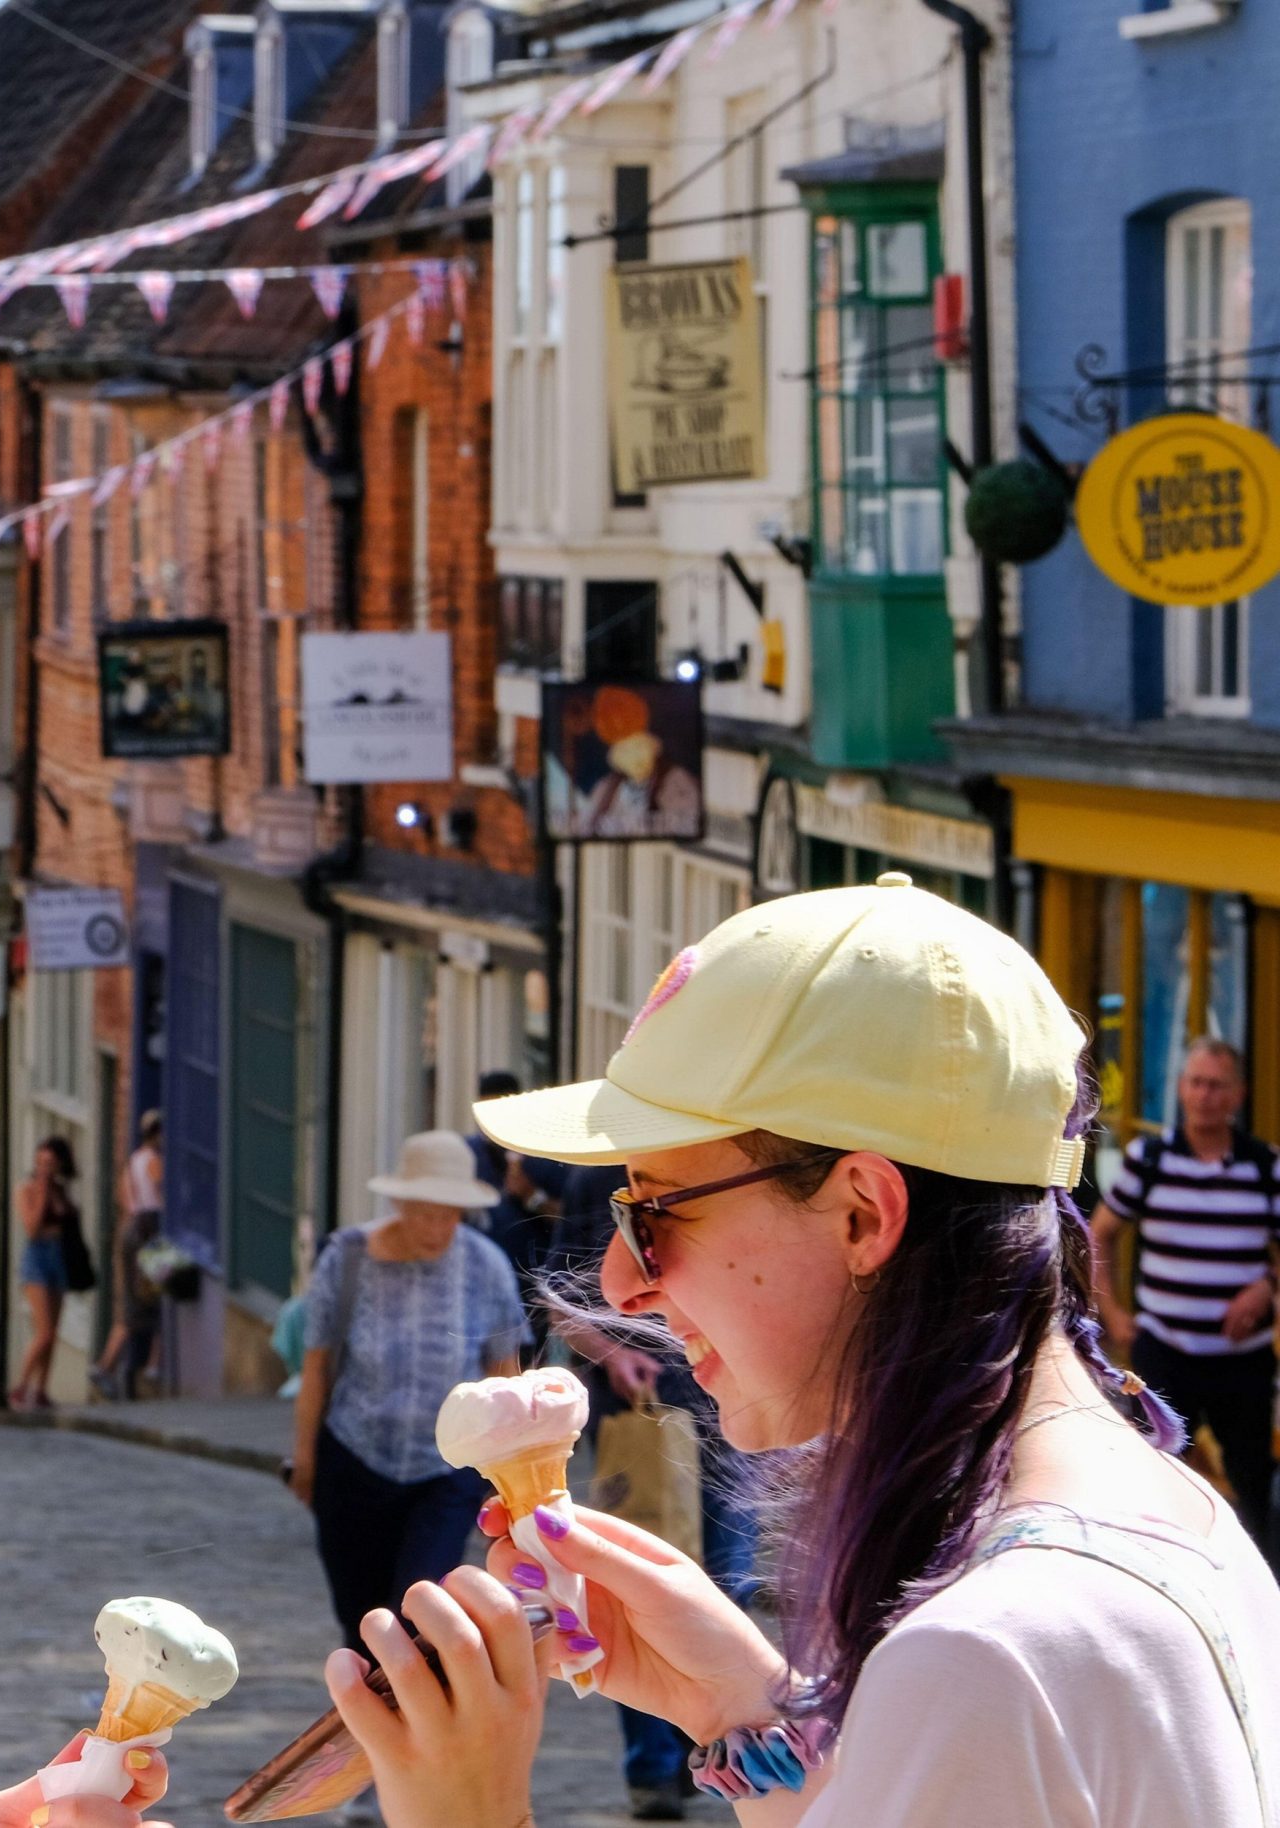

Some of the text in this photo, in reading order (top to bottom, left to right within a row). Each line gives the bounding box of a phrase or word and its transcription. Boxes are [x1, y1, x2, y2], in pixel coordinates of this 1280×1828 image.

[620, 269, 743, 330] BROWNS
[687, 402, 725, 436] SHOP
[1174, 453, 1204, 474] THE
[1136, 467, 1243, 519] MOUSE
[1141, 511, 1245, 562] HOUSE
